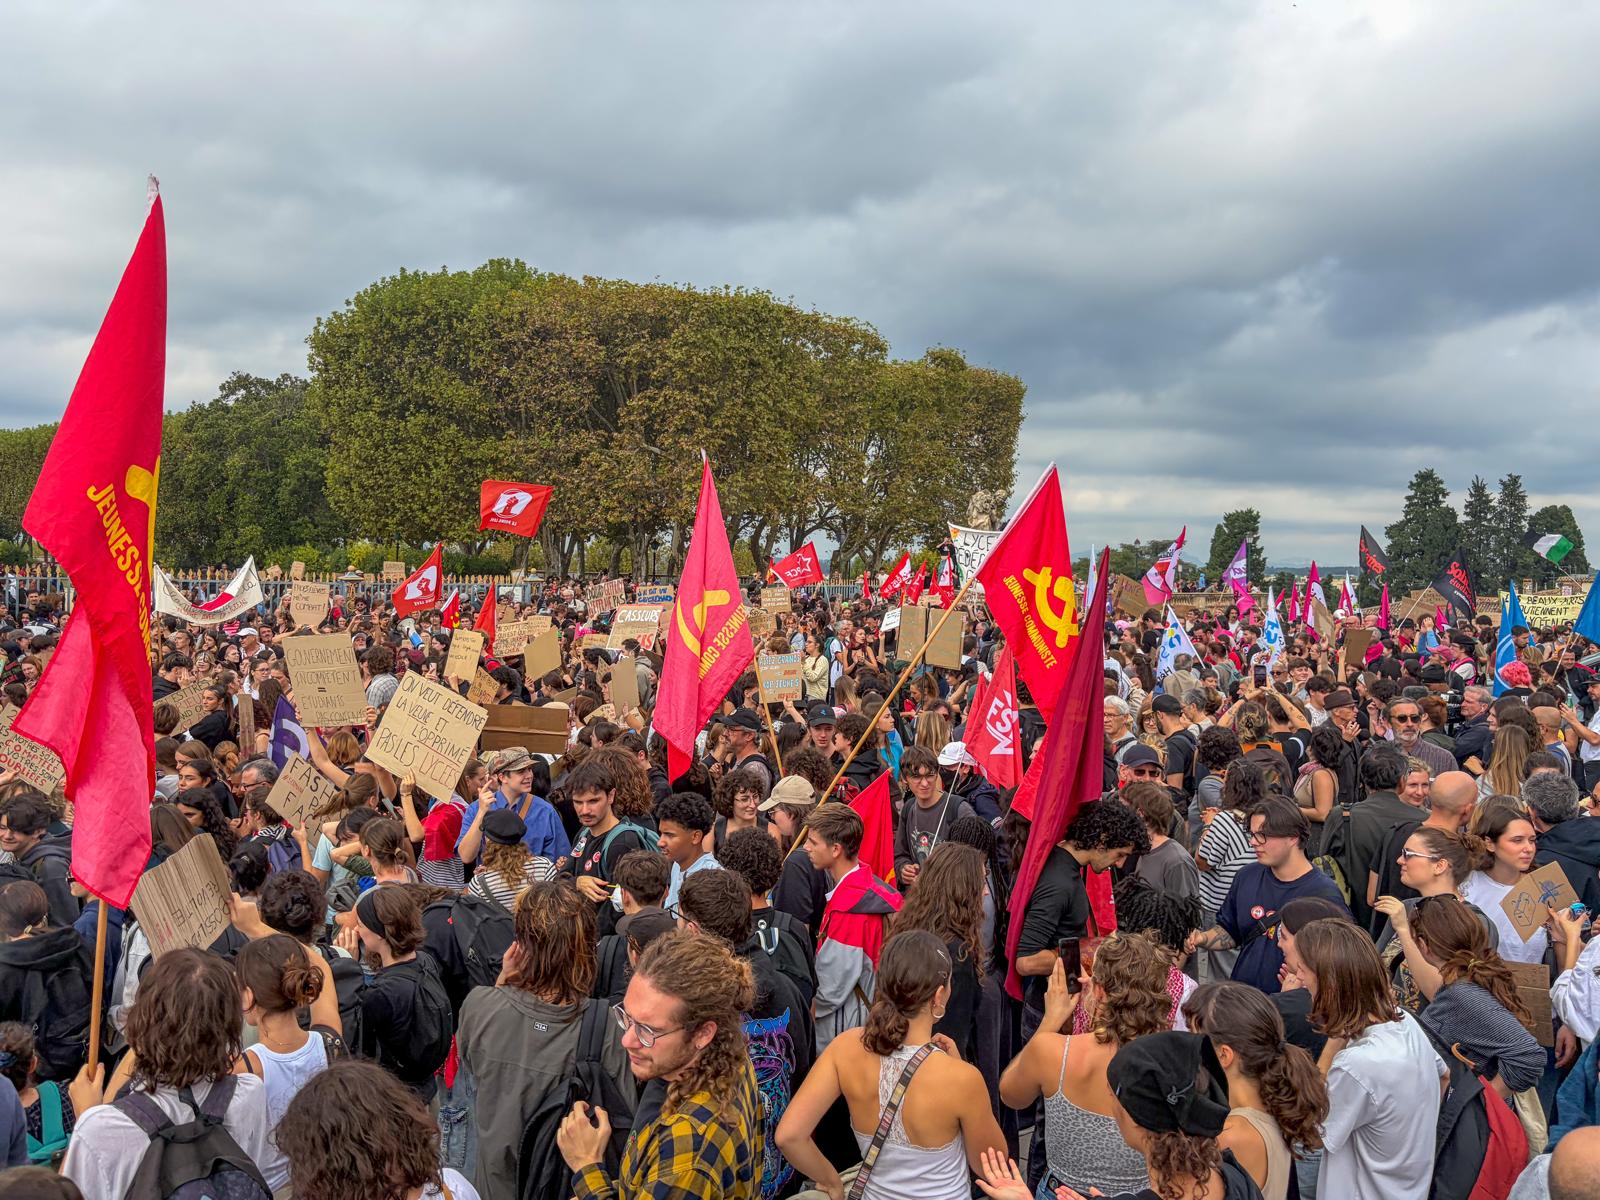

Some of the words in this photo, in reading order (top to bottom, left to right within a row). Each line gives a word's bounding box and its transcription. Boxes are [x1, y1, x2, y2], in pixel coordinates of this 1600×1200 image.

[1003, 575, 1029, 615] JEUNESSE
[1024, 614, 1057, 669] COMMUNISTE
[401, 675, 418, 694] ON
[419, 682, 443, 705] VEUT
[396, 695, 408, 712] LA
[434, 717, 449, 733] ET
[376, 727, 398, 753] PAS
[393, 735, 419, 767] LES
[411, 724, 471, 764] L'OPPRIMÉ
